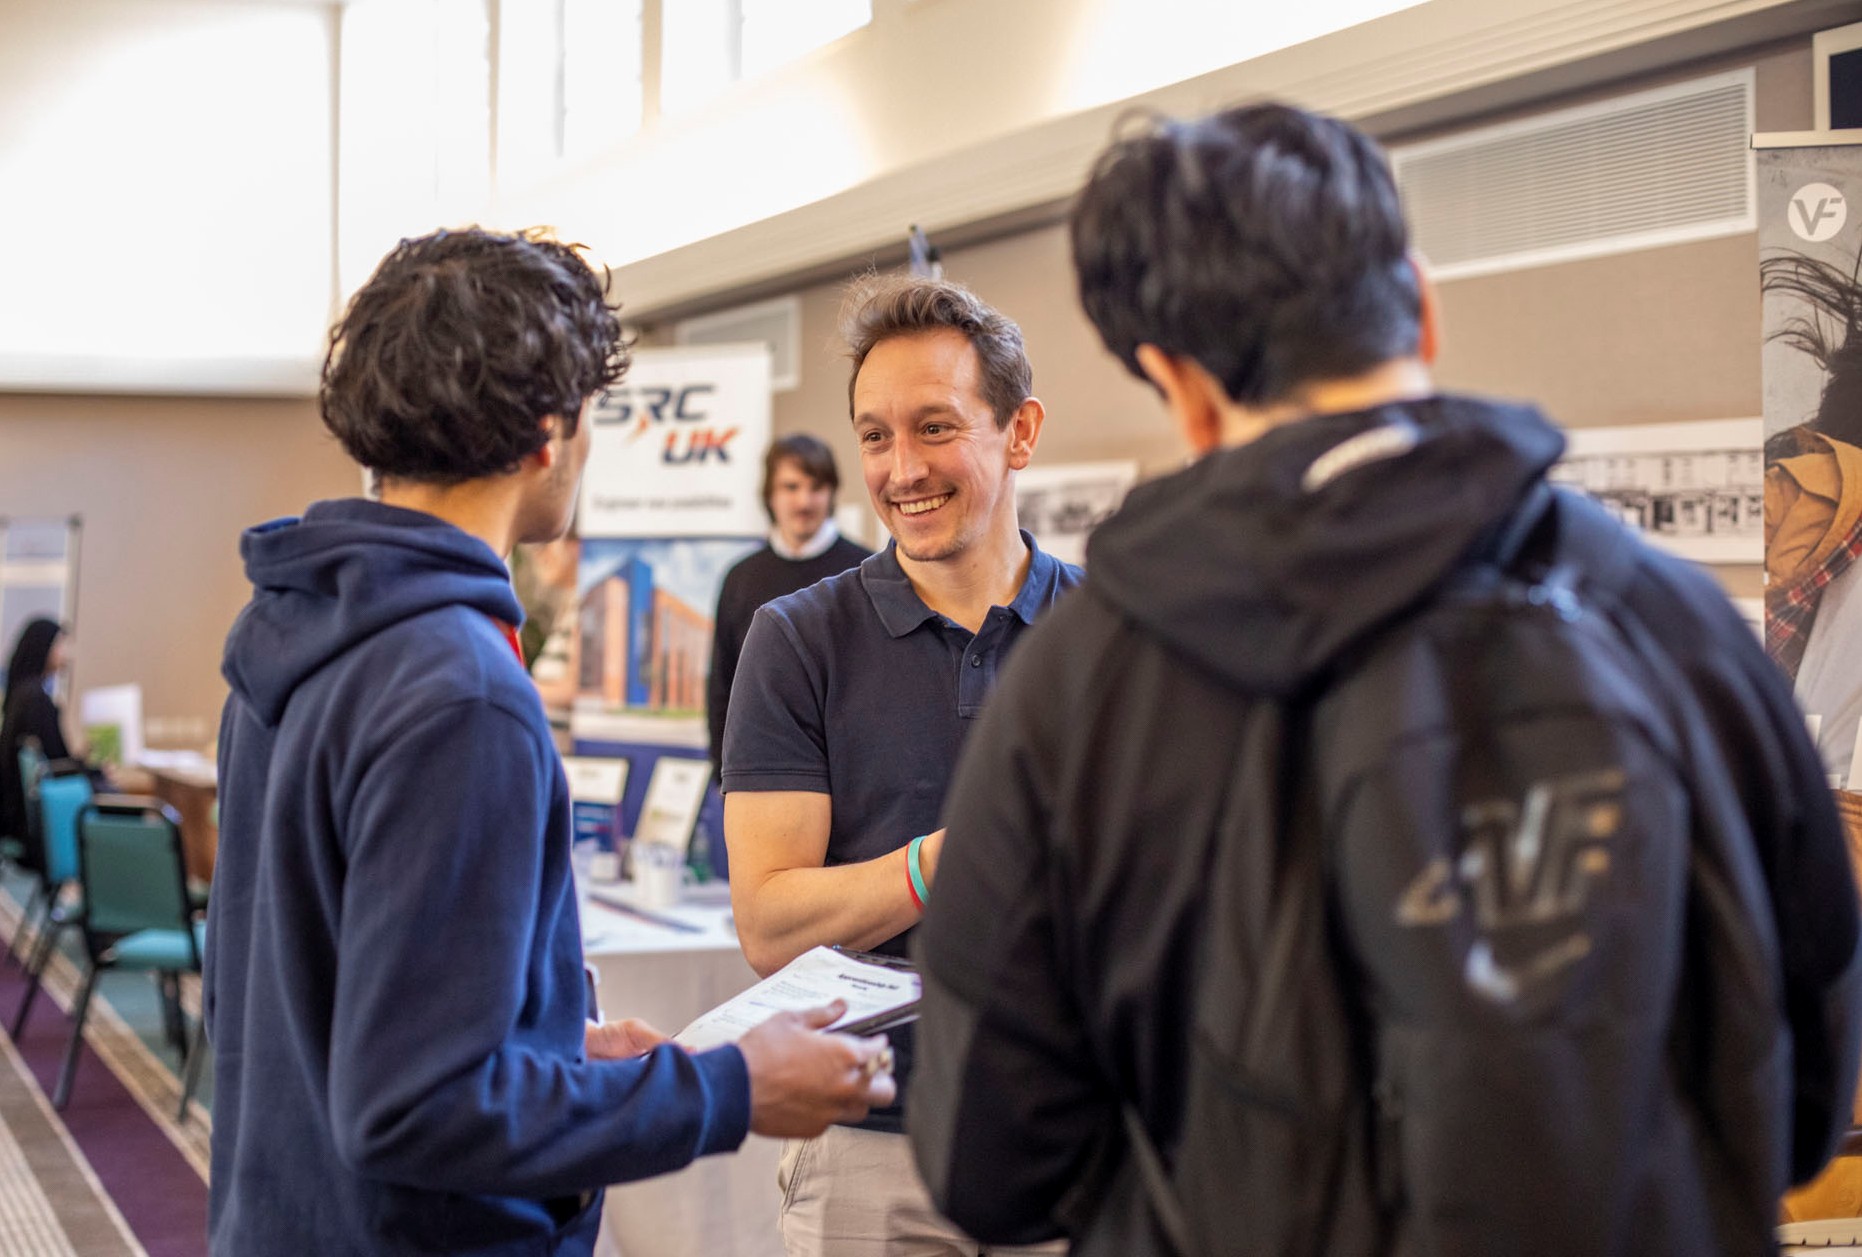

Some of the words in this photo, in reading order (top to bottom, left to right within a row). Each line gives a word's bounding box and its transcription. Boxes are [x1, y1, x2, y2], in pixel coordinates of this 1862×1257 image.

[1793, 197, 1844, 236] VF
[594, 384, 715, 425] SRC
[662, 426, 739, 465] UK
